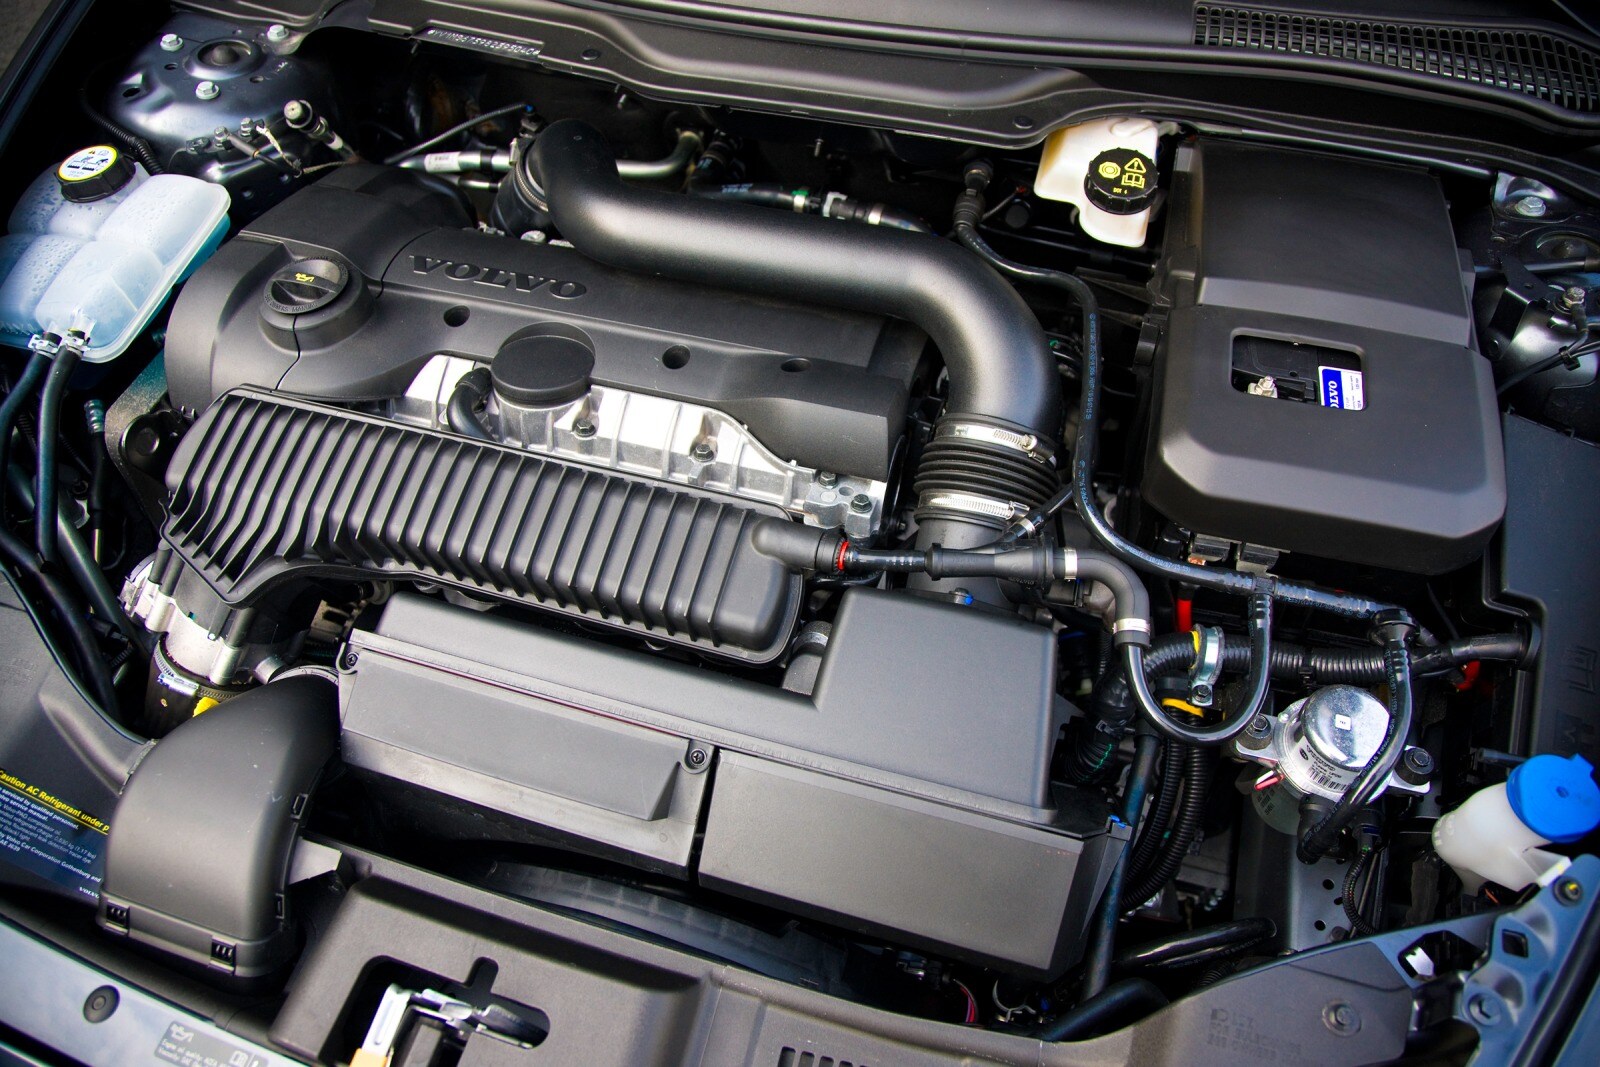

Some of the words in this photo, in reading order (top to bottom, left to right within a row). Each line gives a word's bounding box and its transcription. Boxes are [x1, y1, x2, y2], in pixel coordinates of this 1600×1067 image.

[409, 255, 587, 299] VOLVO
[2, 788, 24, 802] serviced
[23, 799, 31, 807] by
[30, 803, 54, 818] qualified
[52, 813, 79, 829] personnel.
[9, 800, 28, 811] service
[26, 785, 39, 796] AC
[39, 791, 81, 817] Refrigerant
[81, 811, 103, 828] under
[6, 834, 21, 845] Volvo
[21, 841, 31, 850] Car
[30, 846, 61, 864] Corporation
[61, 860, 91, 880] Gothenburg
[91, 873, 101, 883] and
